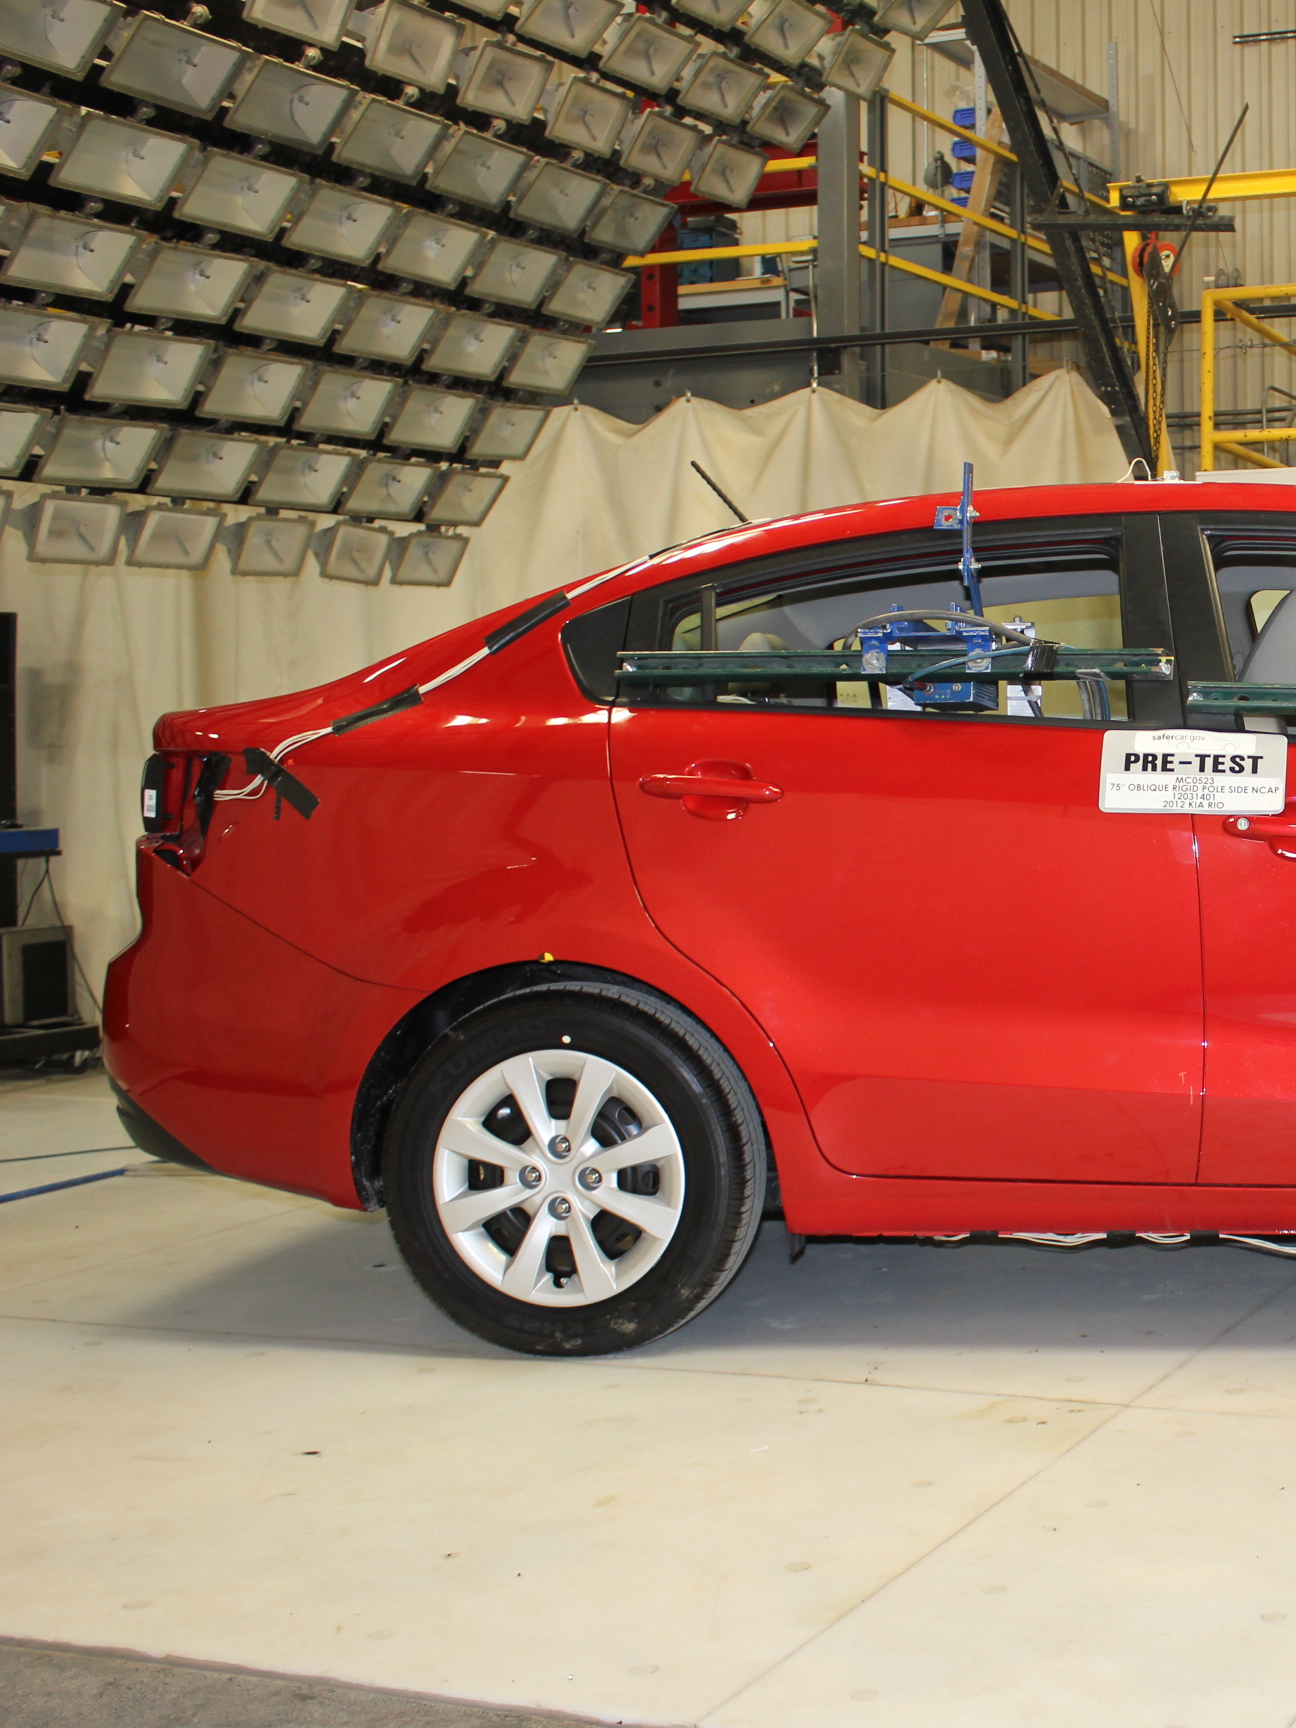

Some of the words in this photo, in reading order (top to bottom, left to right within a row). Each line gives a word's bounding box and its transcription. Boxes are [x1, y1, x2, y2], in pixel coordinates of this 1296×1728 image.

[1152, 733, 1205, 741] safercar.gov
[1124, 753, 1263, 774] PRE-TEST
[1128, 784, 1168, 792] OBLIQUE
[1202, 785, 1225, 793] POLE
[1252, 786, 1279, 794] NCAP
[428, 1019, 545, 1096] KUMHO
